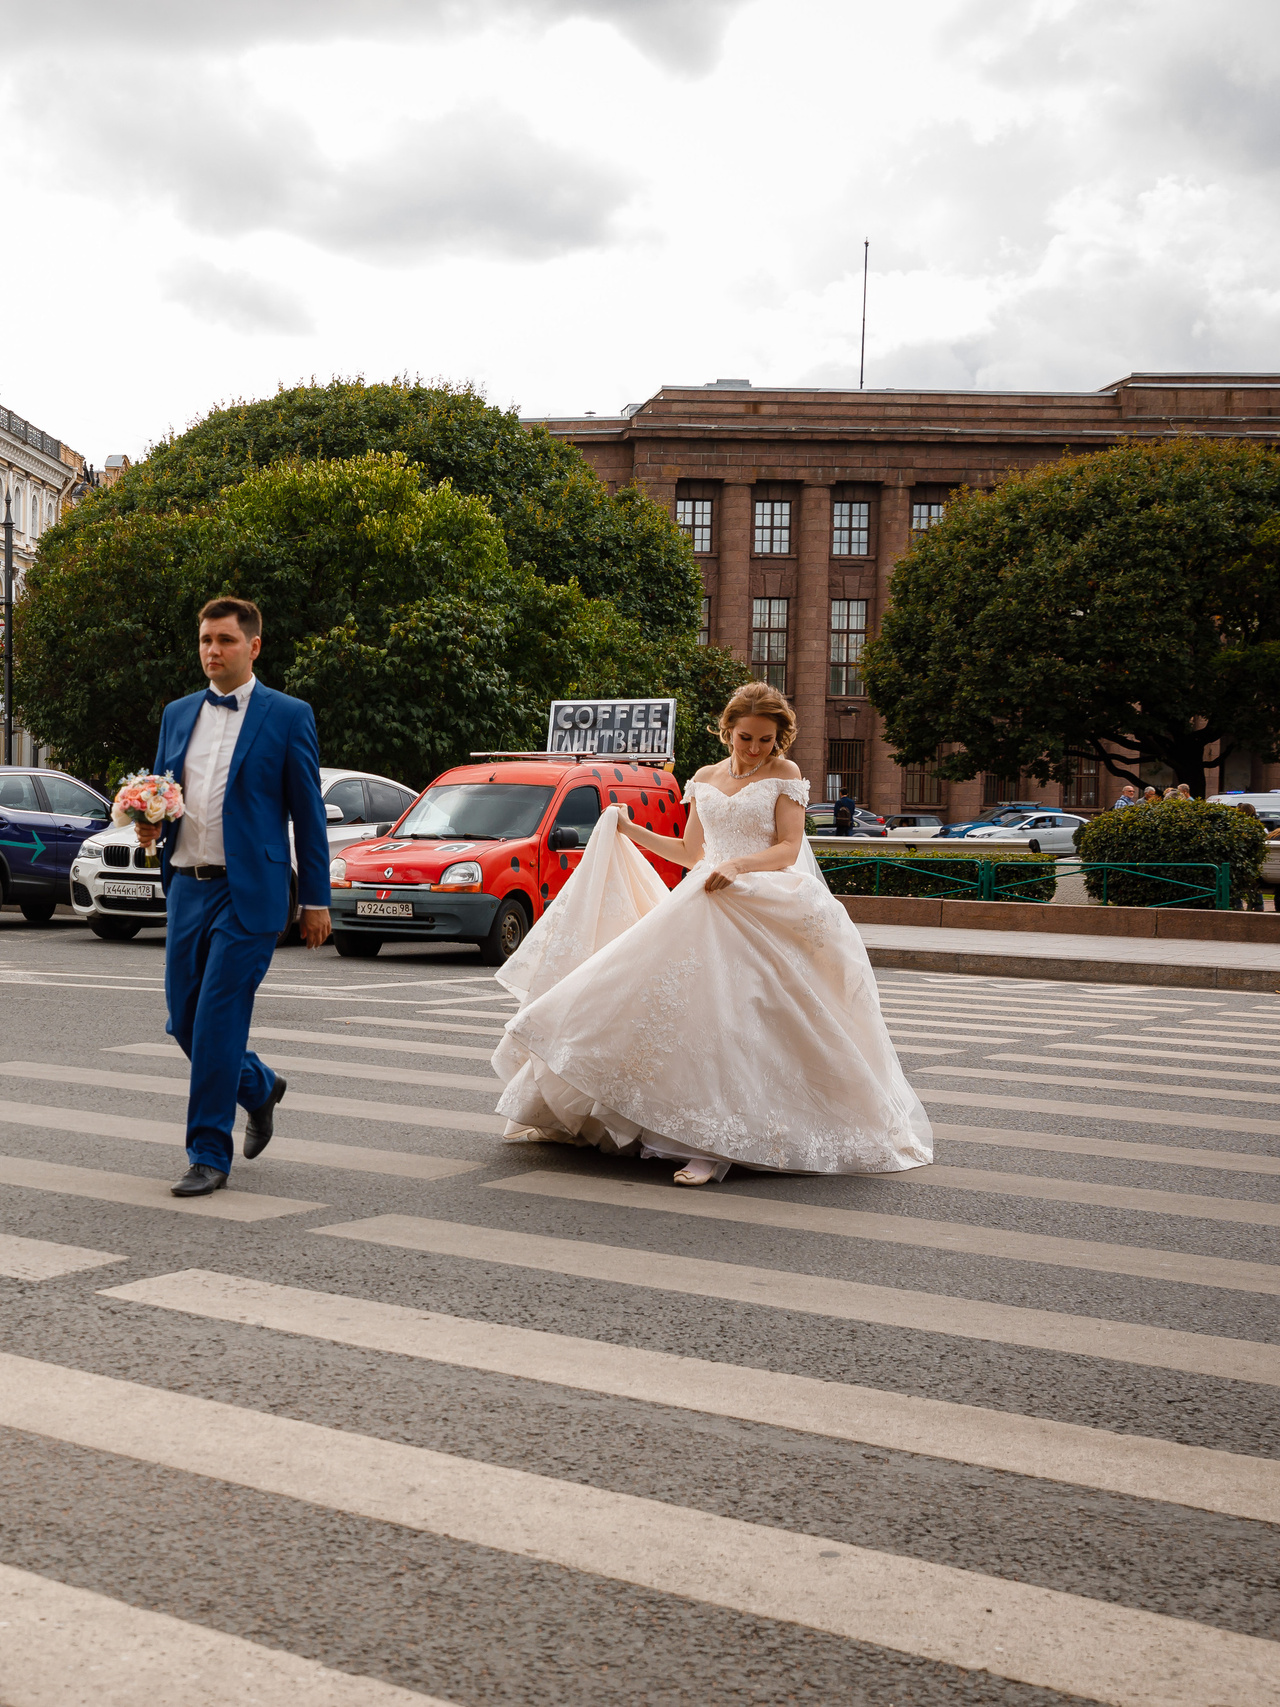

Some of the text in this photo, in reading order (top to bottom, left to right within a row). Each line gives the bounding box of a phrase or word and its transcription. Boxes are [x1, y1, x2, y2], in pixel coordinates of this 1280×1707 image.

[556, 704, 663, 729] COFFEE
[138, 885, 151, 894] 178
[400, 904, 410, 912] 98
